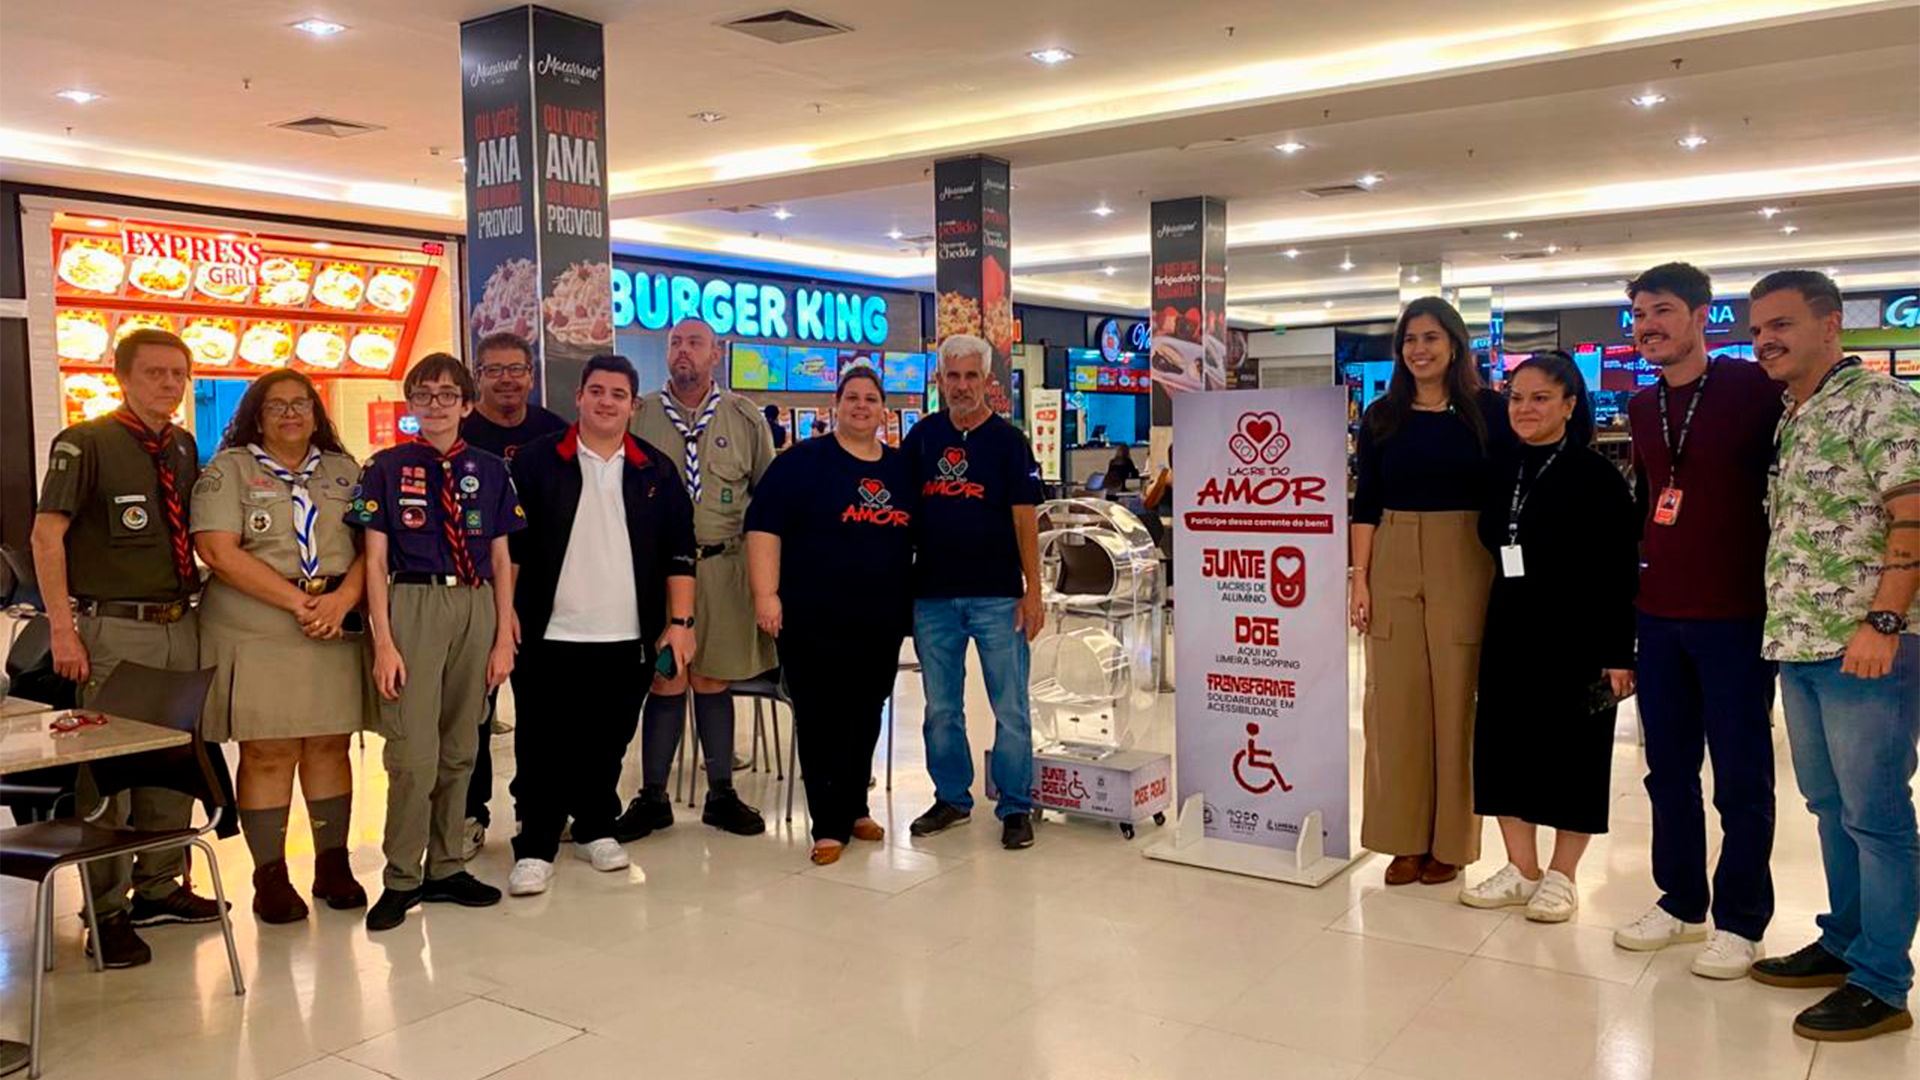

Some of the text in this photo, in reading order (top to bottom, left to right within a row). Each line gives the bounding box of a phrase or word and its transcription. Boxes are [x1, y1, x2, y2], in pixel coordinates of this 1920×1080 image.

[544, 104, 562, 131] OU
[477, 135, 522, 187] AMA
[546, 133, 600, 186] AMA
[478, 205, 523, 239] PROVOU
[547, 203, 602, 238] PROVOU
[122, 229, 263, 266] EXPRESS
[611, 268, 888, 345] BURGER KING
[1228, 466, 1290, 476] LACRE DO
[922, 480, 985, 499] AMOR
[1197, 477, 1326, 506] AMOR
[841, 503, 911, 526] AMOR
[1191, 517, 1329, 528] Participe dessa corrente do bem!
[1202, 549, 1266, 579] JUNTE
[1217, 581, 1266, 592] LACRES DE
[1235, 616, 1279, 646] DOE
[1216, 655, 1301, 669] LIMEIRA SHOPPING
[1237, 646, 1278, 658] AQUI NO
[1207, 673, 1296, 698] TRANSFORME
[1207, 692, 1294, 709] SOLIDARIEDADE EM
[1207, 703, 1279, 717] ACESSIBILIDADE
